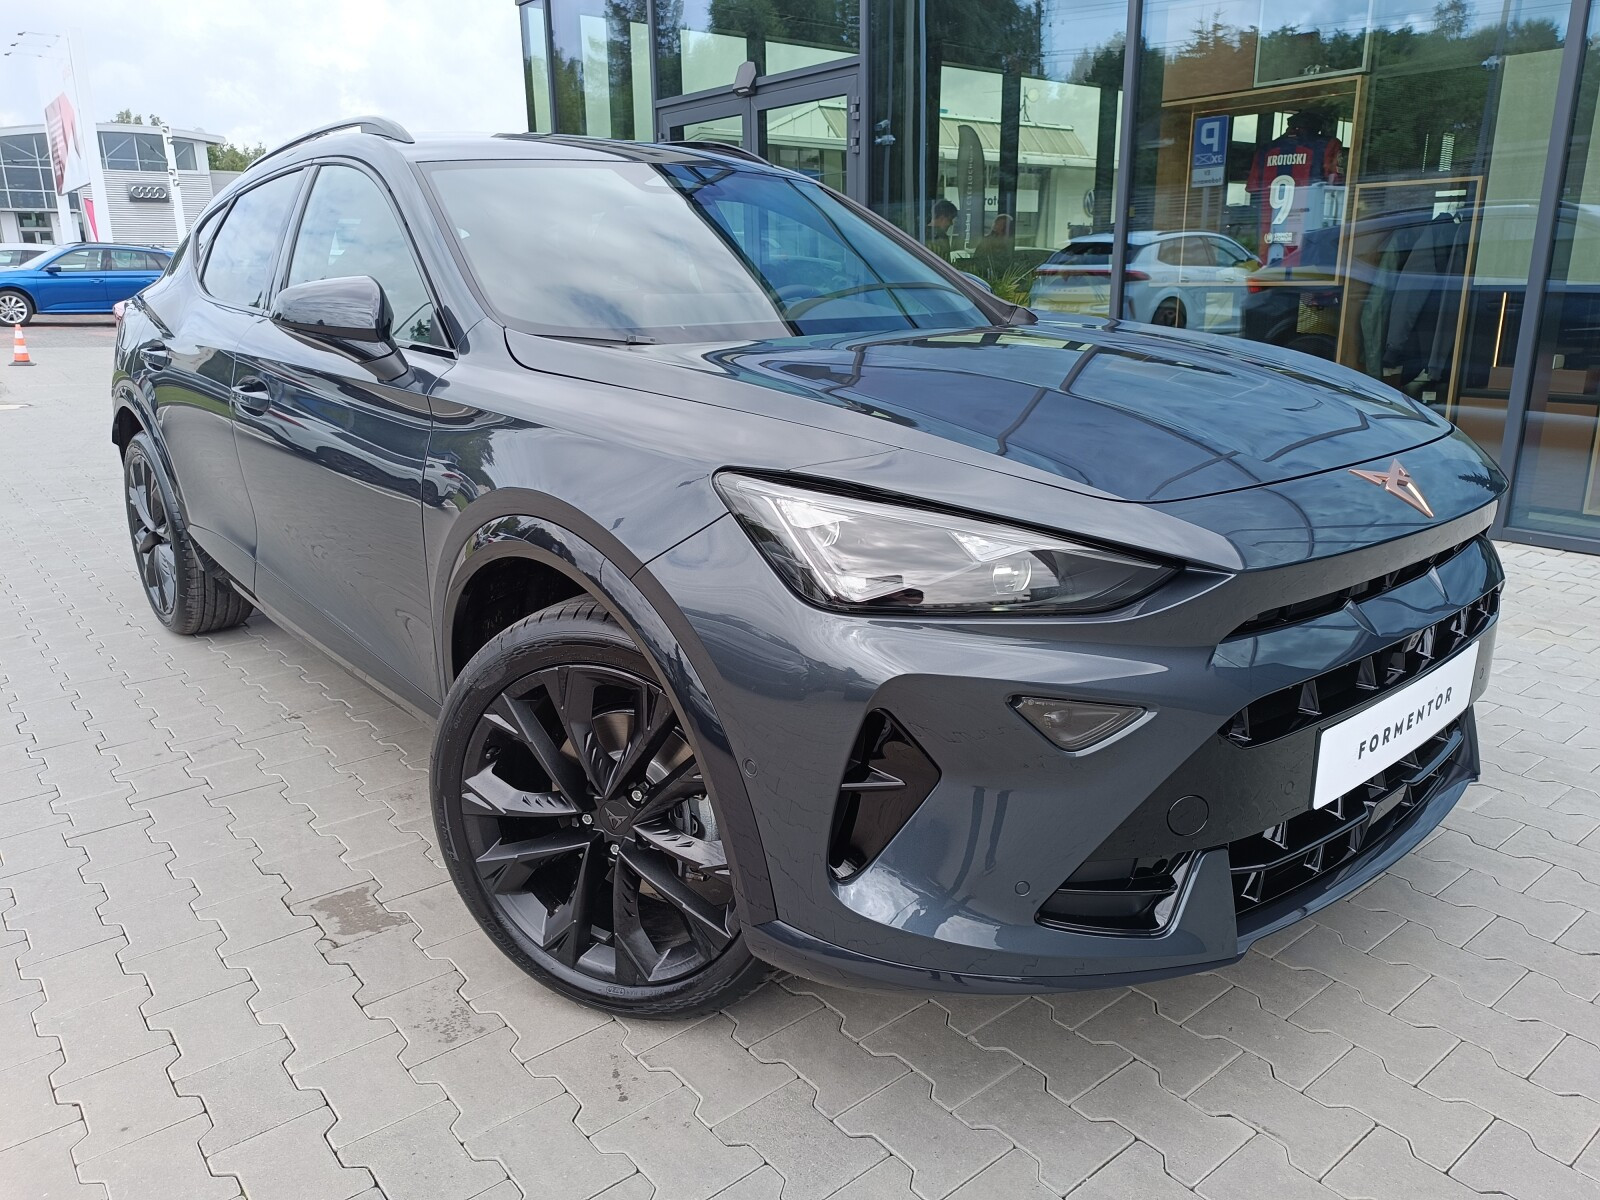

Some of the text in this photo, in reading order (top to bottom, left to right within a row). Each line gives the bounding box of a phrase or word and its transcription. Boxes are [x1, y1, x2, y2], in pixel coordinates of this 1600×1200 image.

[1267, 154, 1307, 167] KROTOSKI
[1270, 175, 1295, 225] 9
[1357, 686, 1452, 760] FORMENTOR
